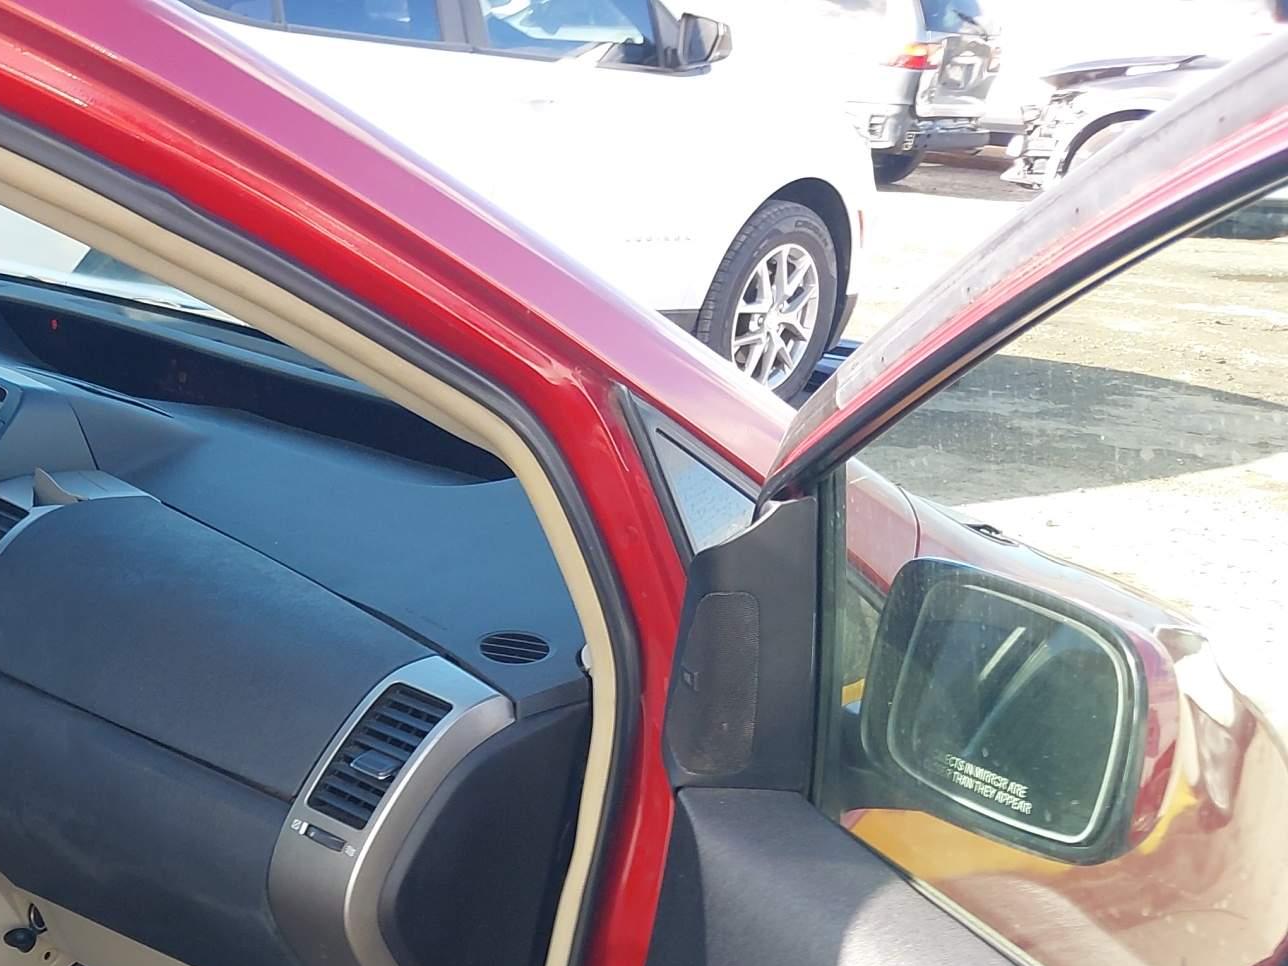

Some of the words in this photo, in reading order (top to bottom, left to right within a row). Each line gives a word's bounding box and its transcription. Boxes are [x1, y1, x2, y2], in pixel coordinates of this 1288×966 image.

[952, 771, 975, 790] THAN
[973, 780, 996, 799] THEY
[995, 790, 1033, 815] APPEAR
[963, 762, 974, 776] IN
[973, 766, 1010, 790] MIRROR
[1006, 781, 1030, 799] ARE
